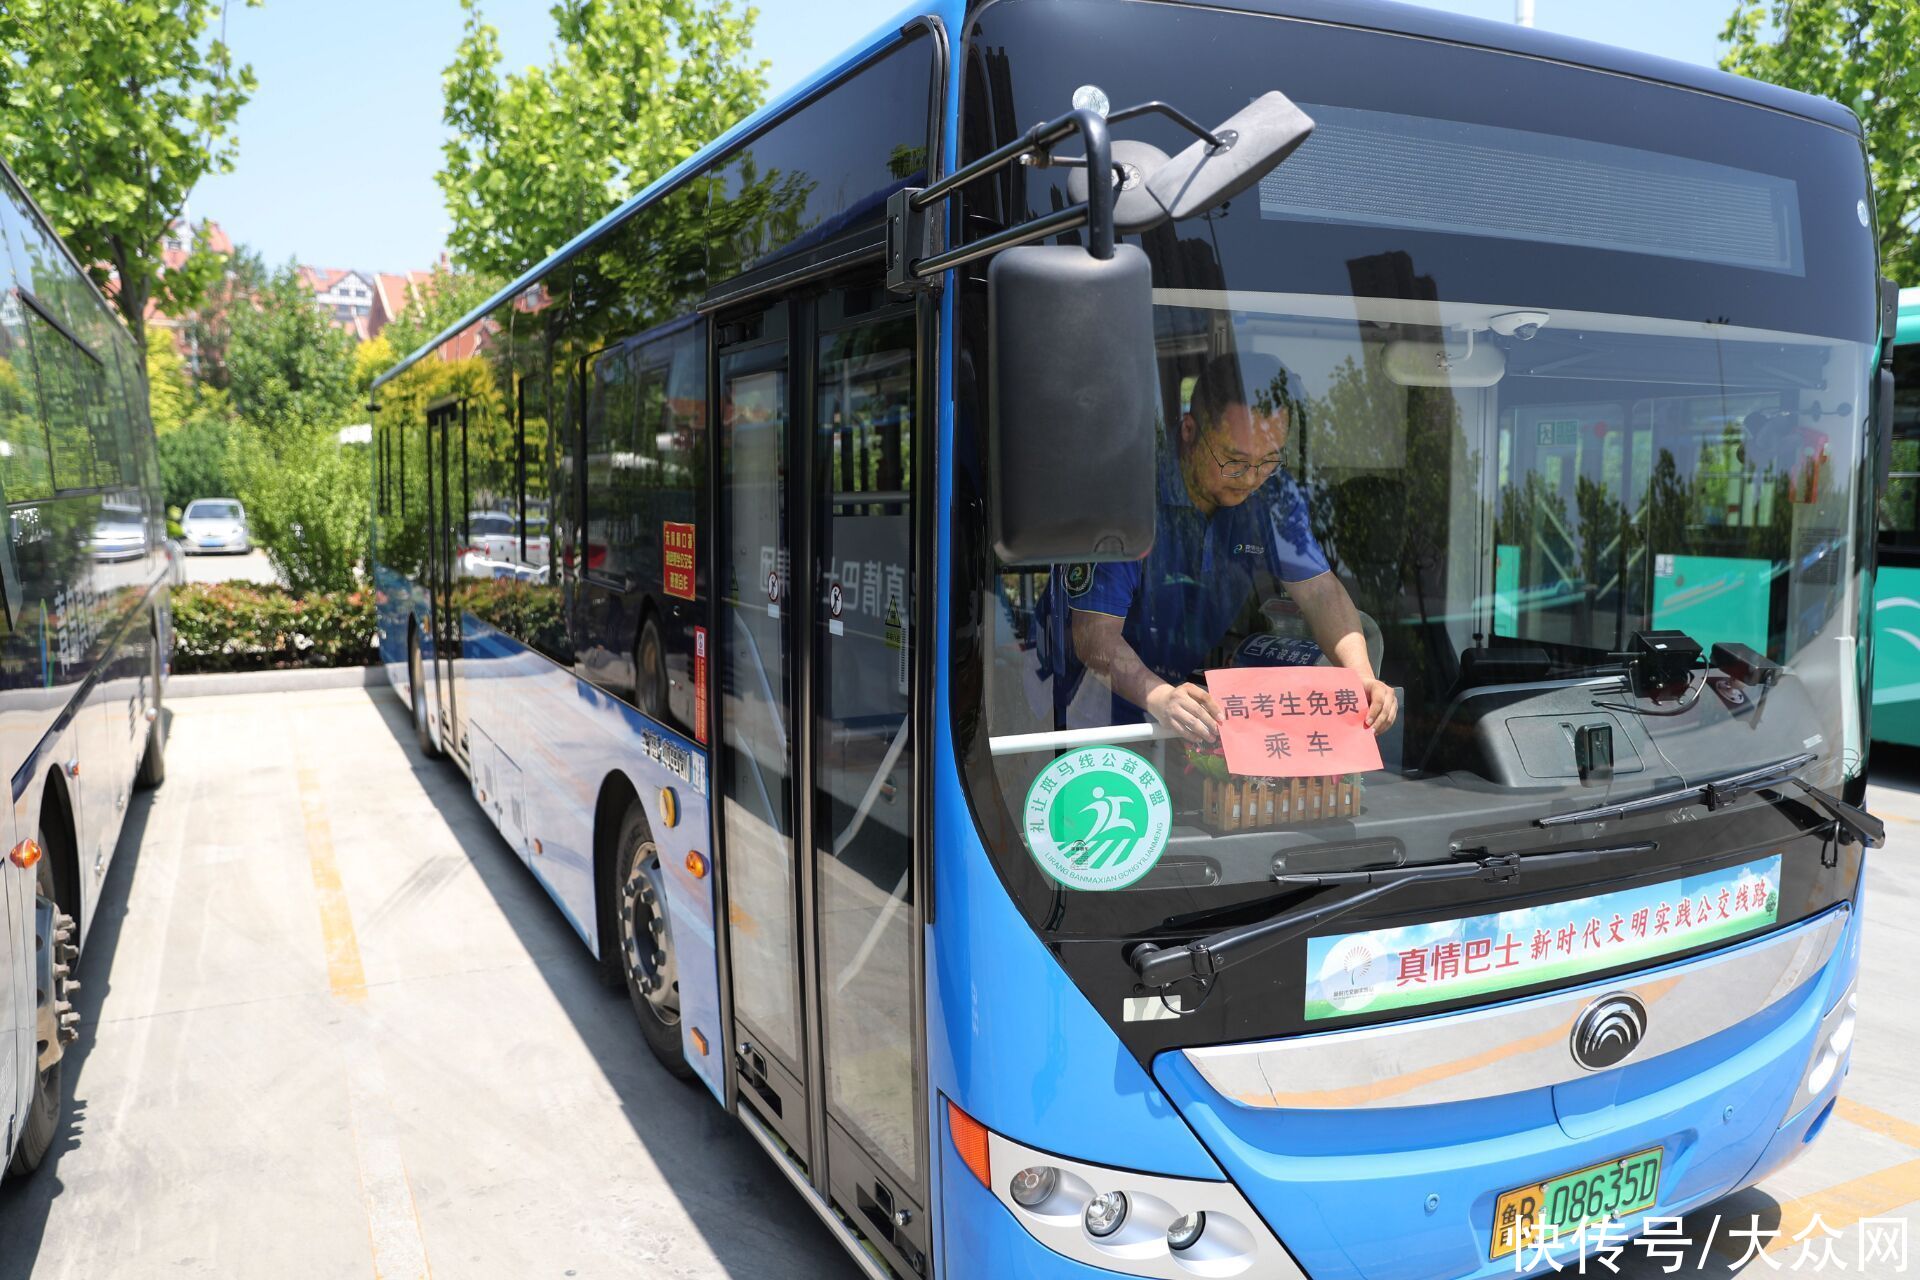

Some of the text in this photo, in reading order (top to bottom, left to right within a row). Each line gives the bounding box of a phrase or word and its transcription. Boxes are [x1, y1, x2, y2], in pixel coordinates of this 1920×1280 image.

[1221, 689, 1359, 720] 高考生免费
[1264, 731, 1333, 760] 乘 车
[1029, 752, 1166, 833] 礼让斑马线公益联盟
[1044, 852, 1070, 877] LIRANG
[1069, 870, 1118, 884] BANMAXIAN
[1396, 879, 1770, 987] 真情巴士 新时代文明实践公交线路
[1551, 1158, 1658, 1228] 08635D
